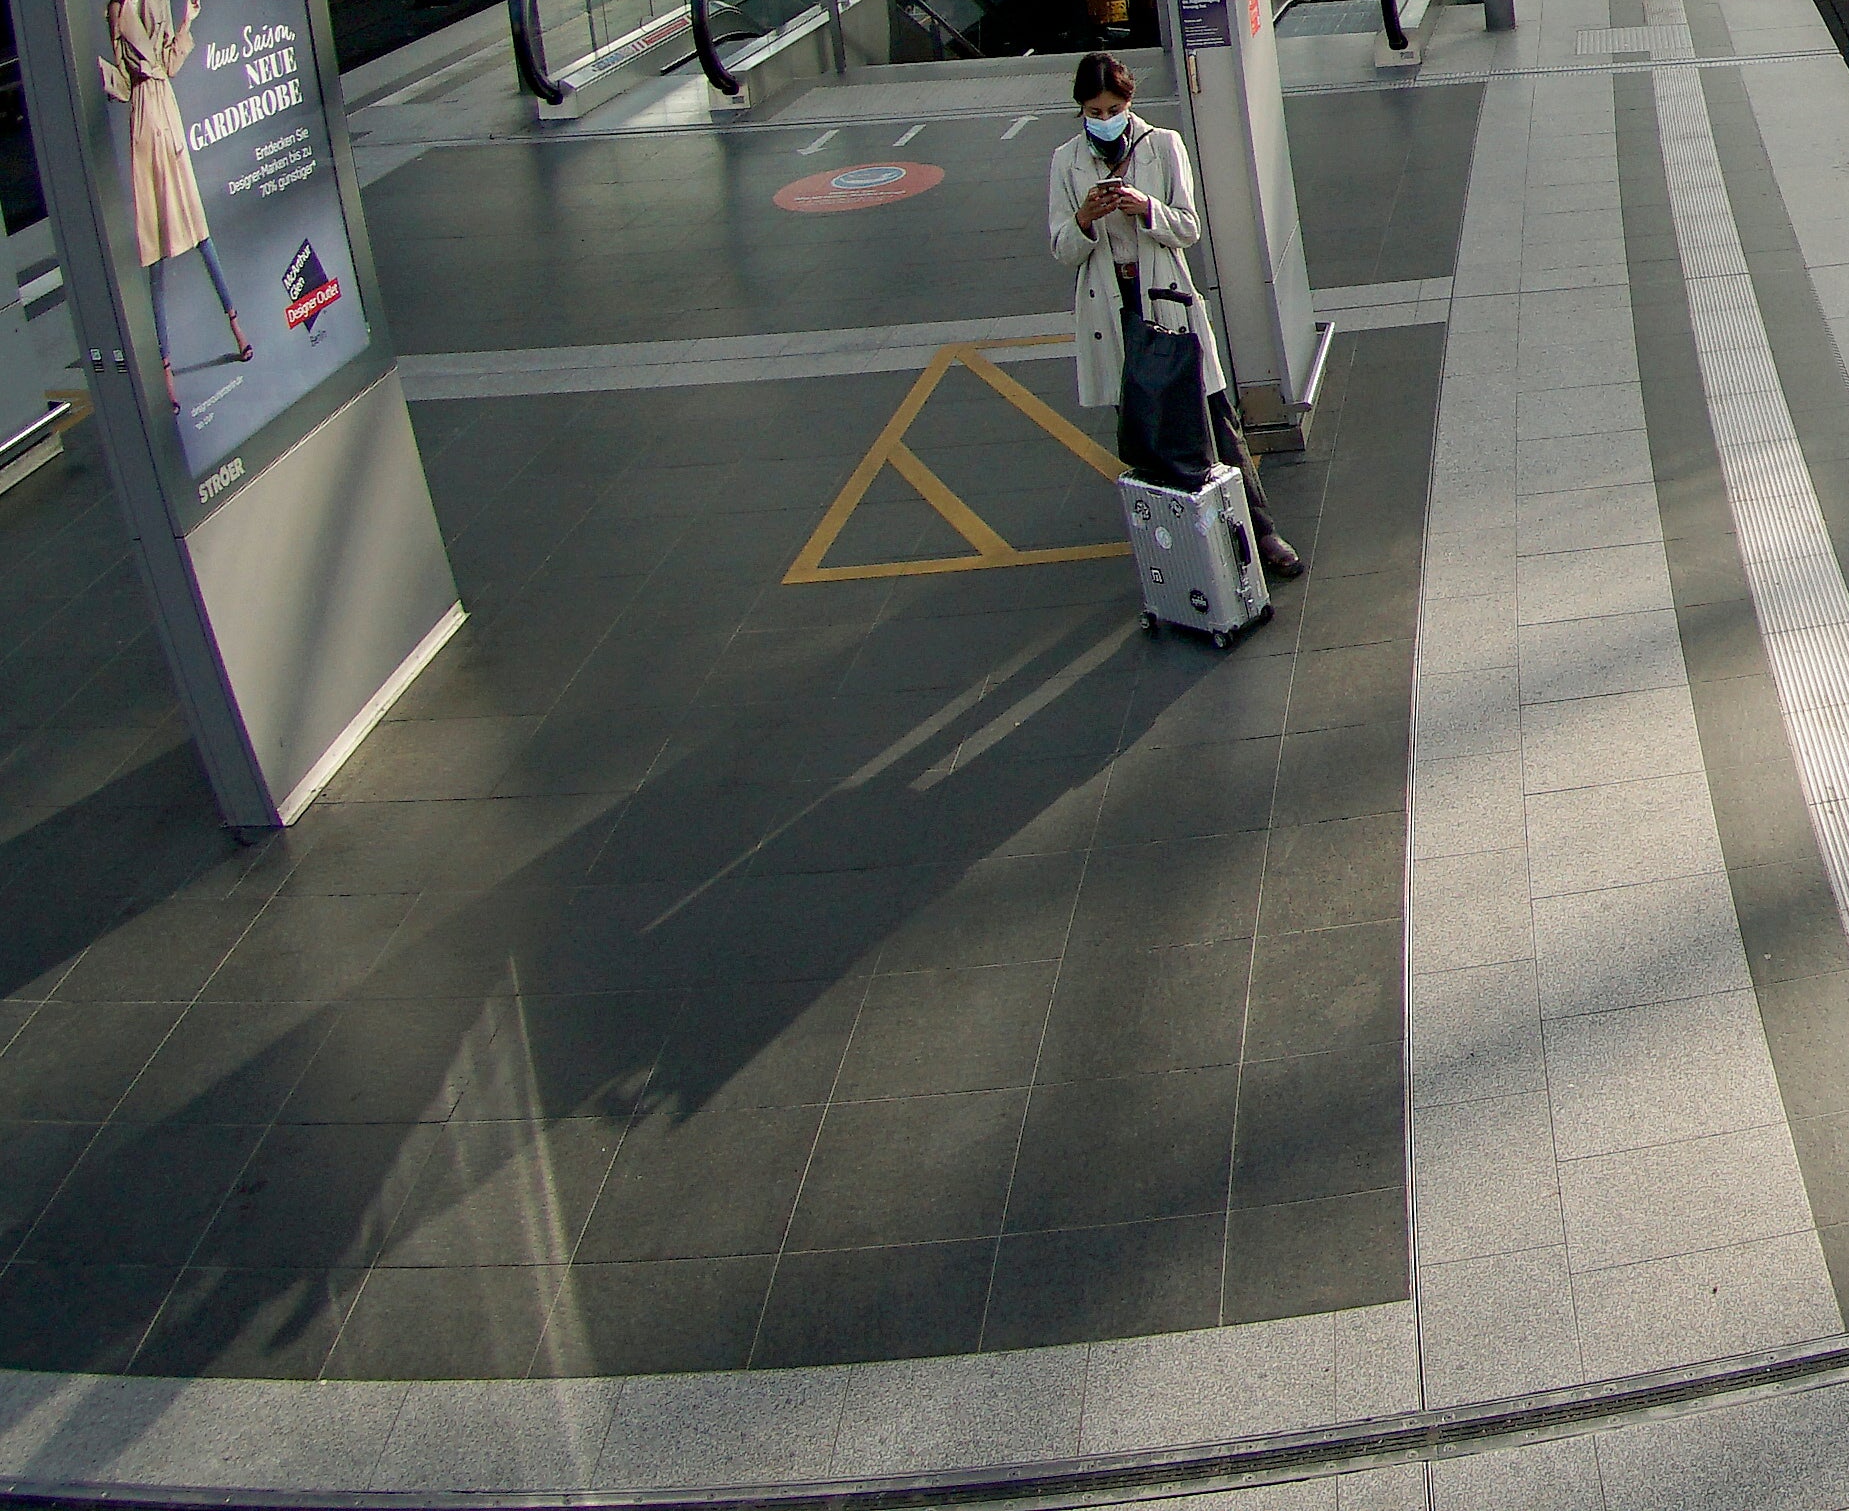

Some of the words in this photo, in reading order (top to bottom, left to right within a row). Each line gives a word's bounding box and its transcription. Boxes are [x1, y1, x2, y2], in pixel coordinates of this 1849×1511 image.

[206, 42, 239, 71] Neue
[242, 24, 296, 58] Saison,
[245, 46, 297, 90] NEUE
[189, 78, 303, 151] GARDEROBE
[255, 138, 296, 161] Entdecken
[295, 127, 310, 142] Sie
[289, 149, 302, 163] bis
[302, 145, 313, 158] zu
[260, 179, 278, 198] 70%
[287, 302, 317, 323] Designer
[316, 283, 339, 304] Outlet
